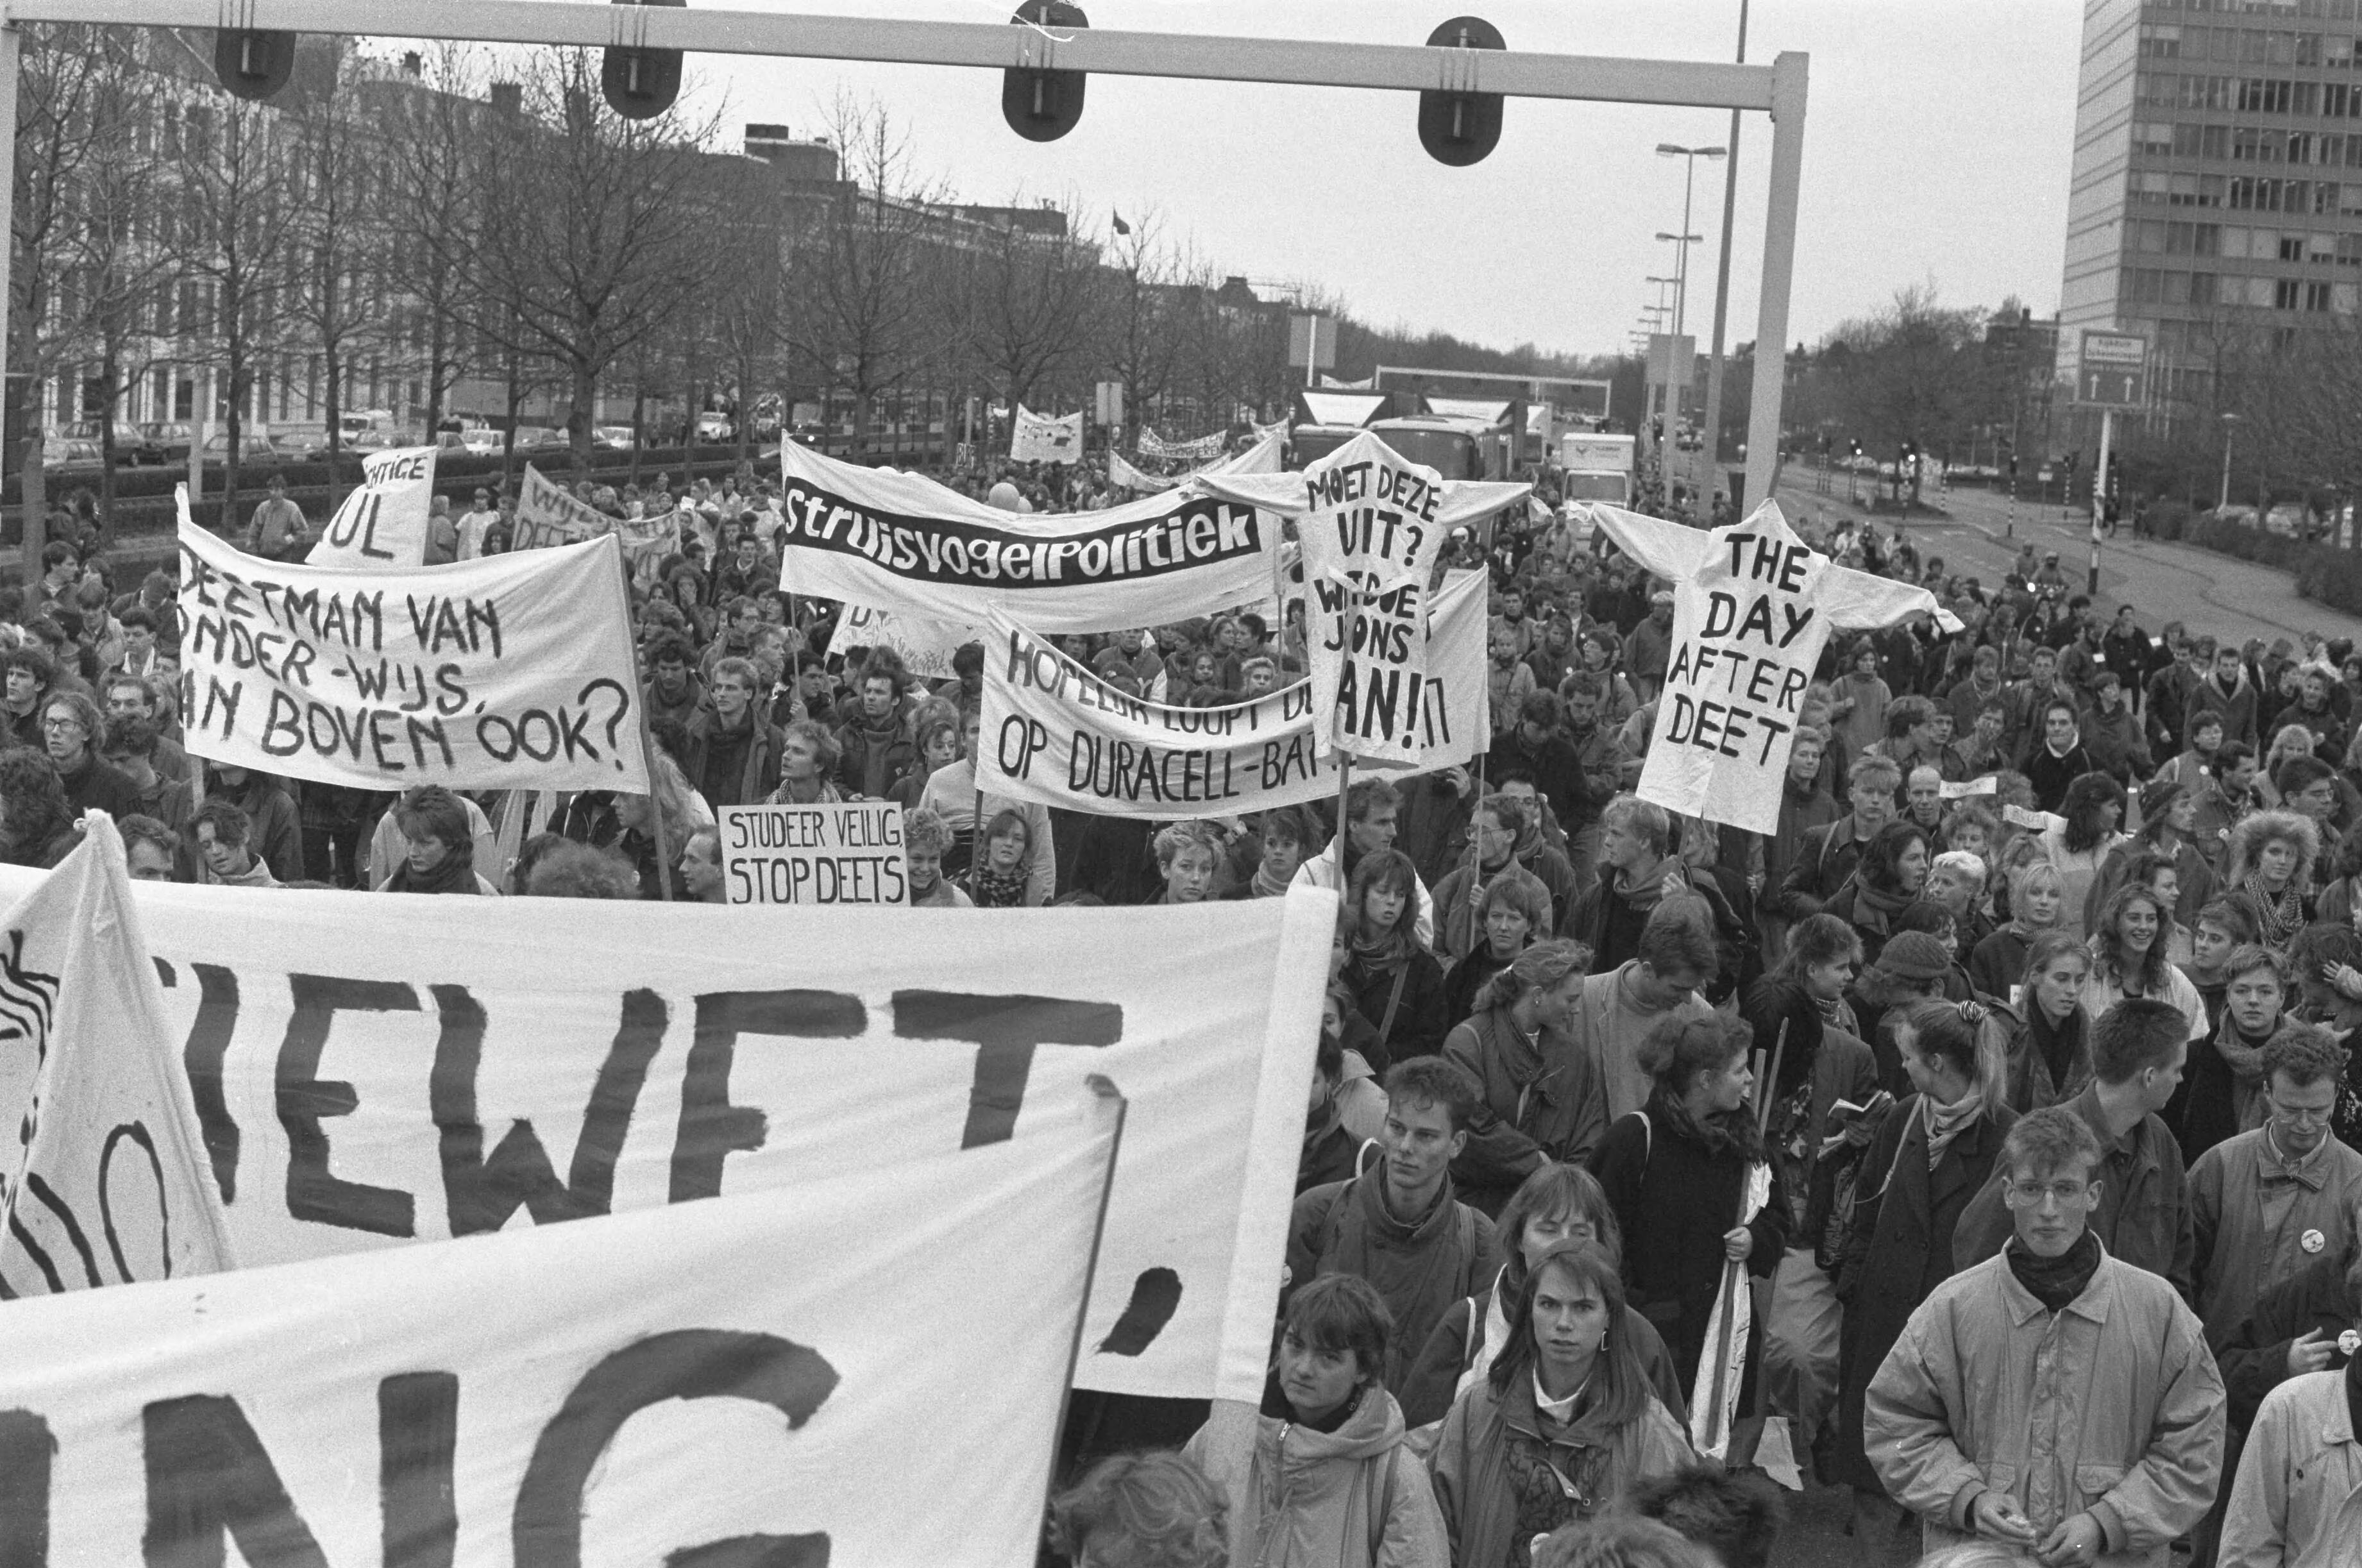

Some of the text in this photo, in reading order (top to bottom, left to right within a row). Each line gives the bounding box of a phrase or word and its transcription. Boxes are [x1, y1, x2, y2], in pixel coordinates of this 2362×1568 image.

[1306, 461, 1441, 523] MOET DEZE
[1725, 533, 1811, 593] THE
[407, 594, 502, 659] VAN
[1700, 591, 1814, 648] DAY
[1668, 642, 1807, 713] AFTER
[261, 688, 455, 770] BOVEN
[476, 677, 629, 771] OOK?
[999, 714, 1048, 780] OP
[1666, 693, 1791, 766] DEET
[729, 809, 903, 848] STUDEER VEILIG,
[730, 856, 905, 904] STOP DEETS
